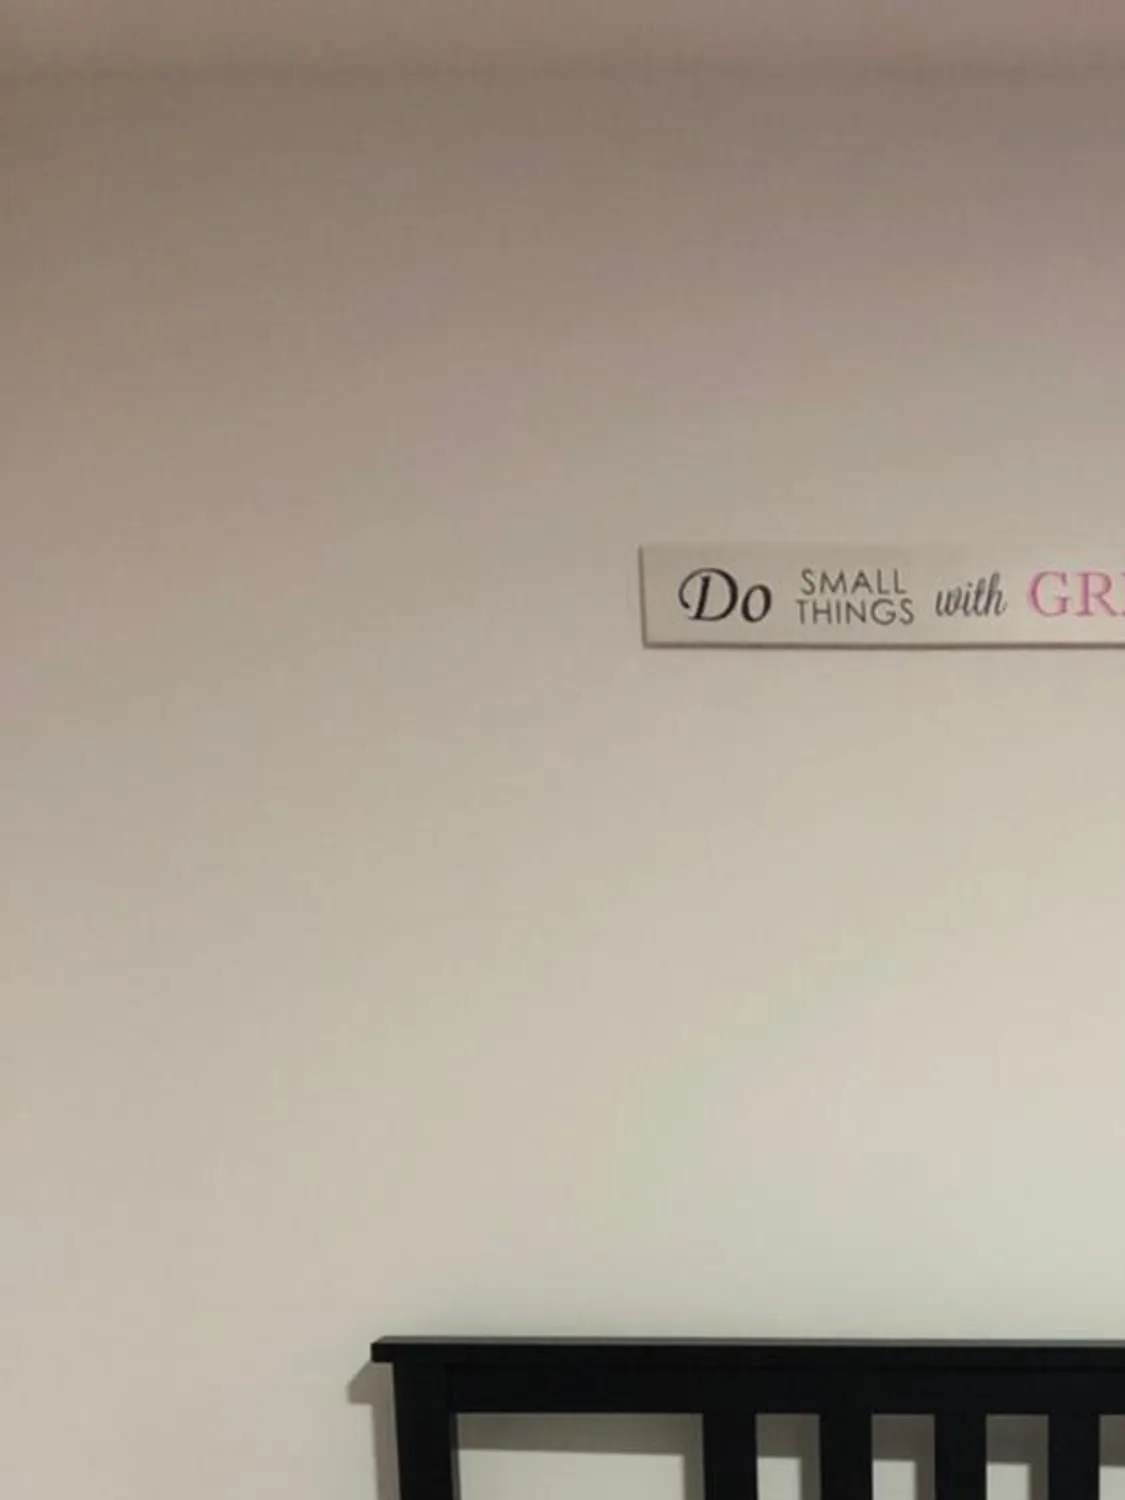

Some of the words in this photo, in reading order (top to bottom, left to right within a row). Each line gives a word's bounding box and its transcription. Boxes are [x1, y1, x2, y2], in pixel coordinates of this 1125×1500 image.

[678, 566, 772, 624] Do
[800, 569, 908, 597] SMALL
[934, 573, 1006, 618] with
[797, 598, 916, 626] THINGS
